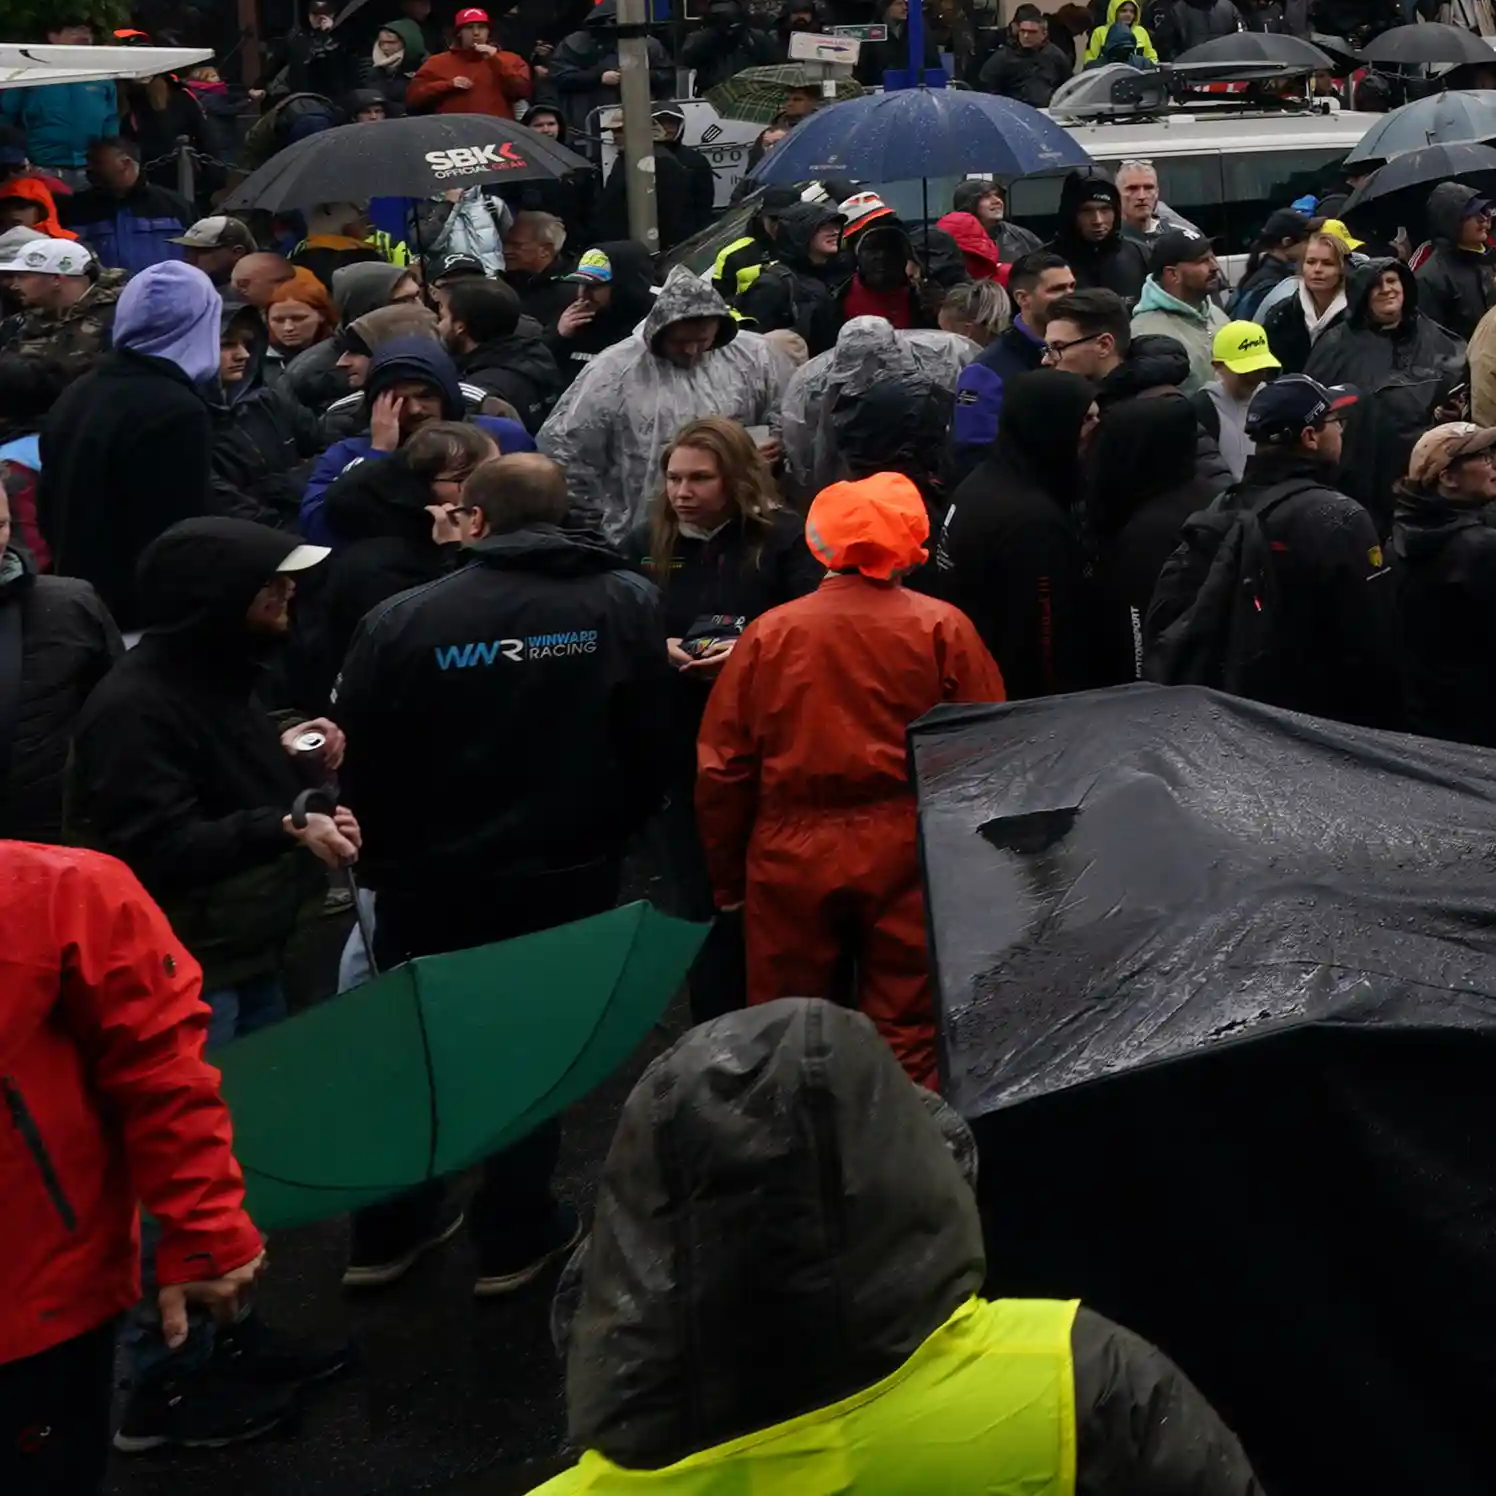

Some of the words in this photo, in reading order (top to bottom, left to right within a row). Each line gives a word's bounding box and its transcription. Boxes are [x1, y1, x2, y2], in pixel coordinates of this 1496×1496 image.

[425, 143, 507, 172] SBK
[434, 163, 493, 180] OFFICIAL
[527, 630, 598, 648] WINWARD
[528, 641, 599, 661] RACING
